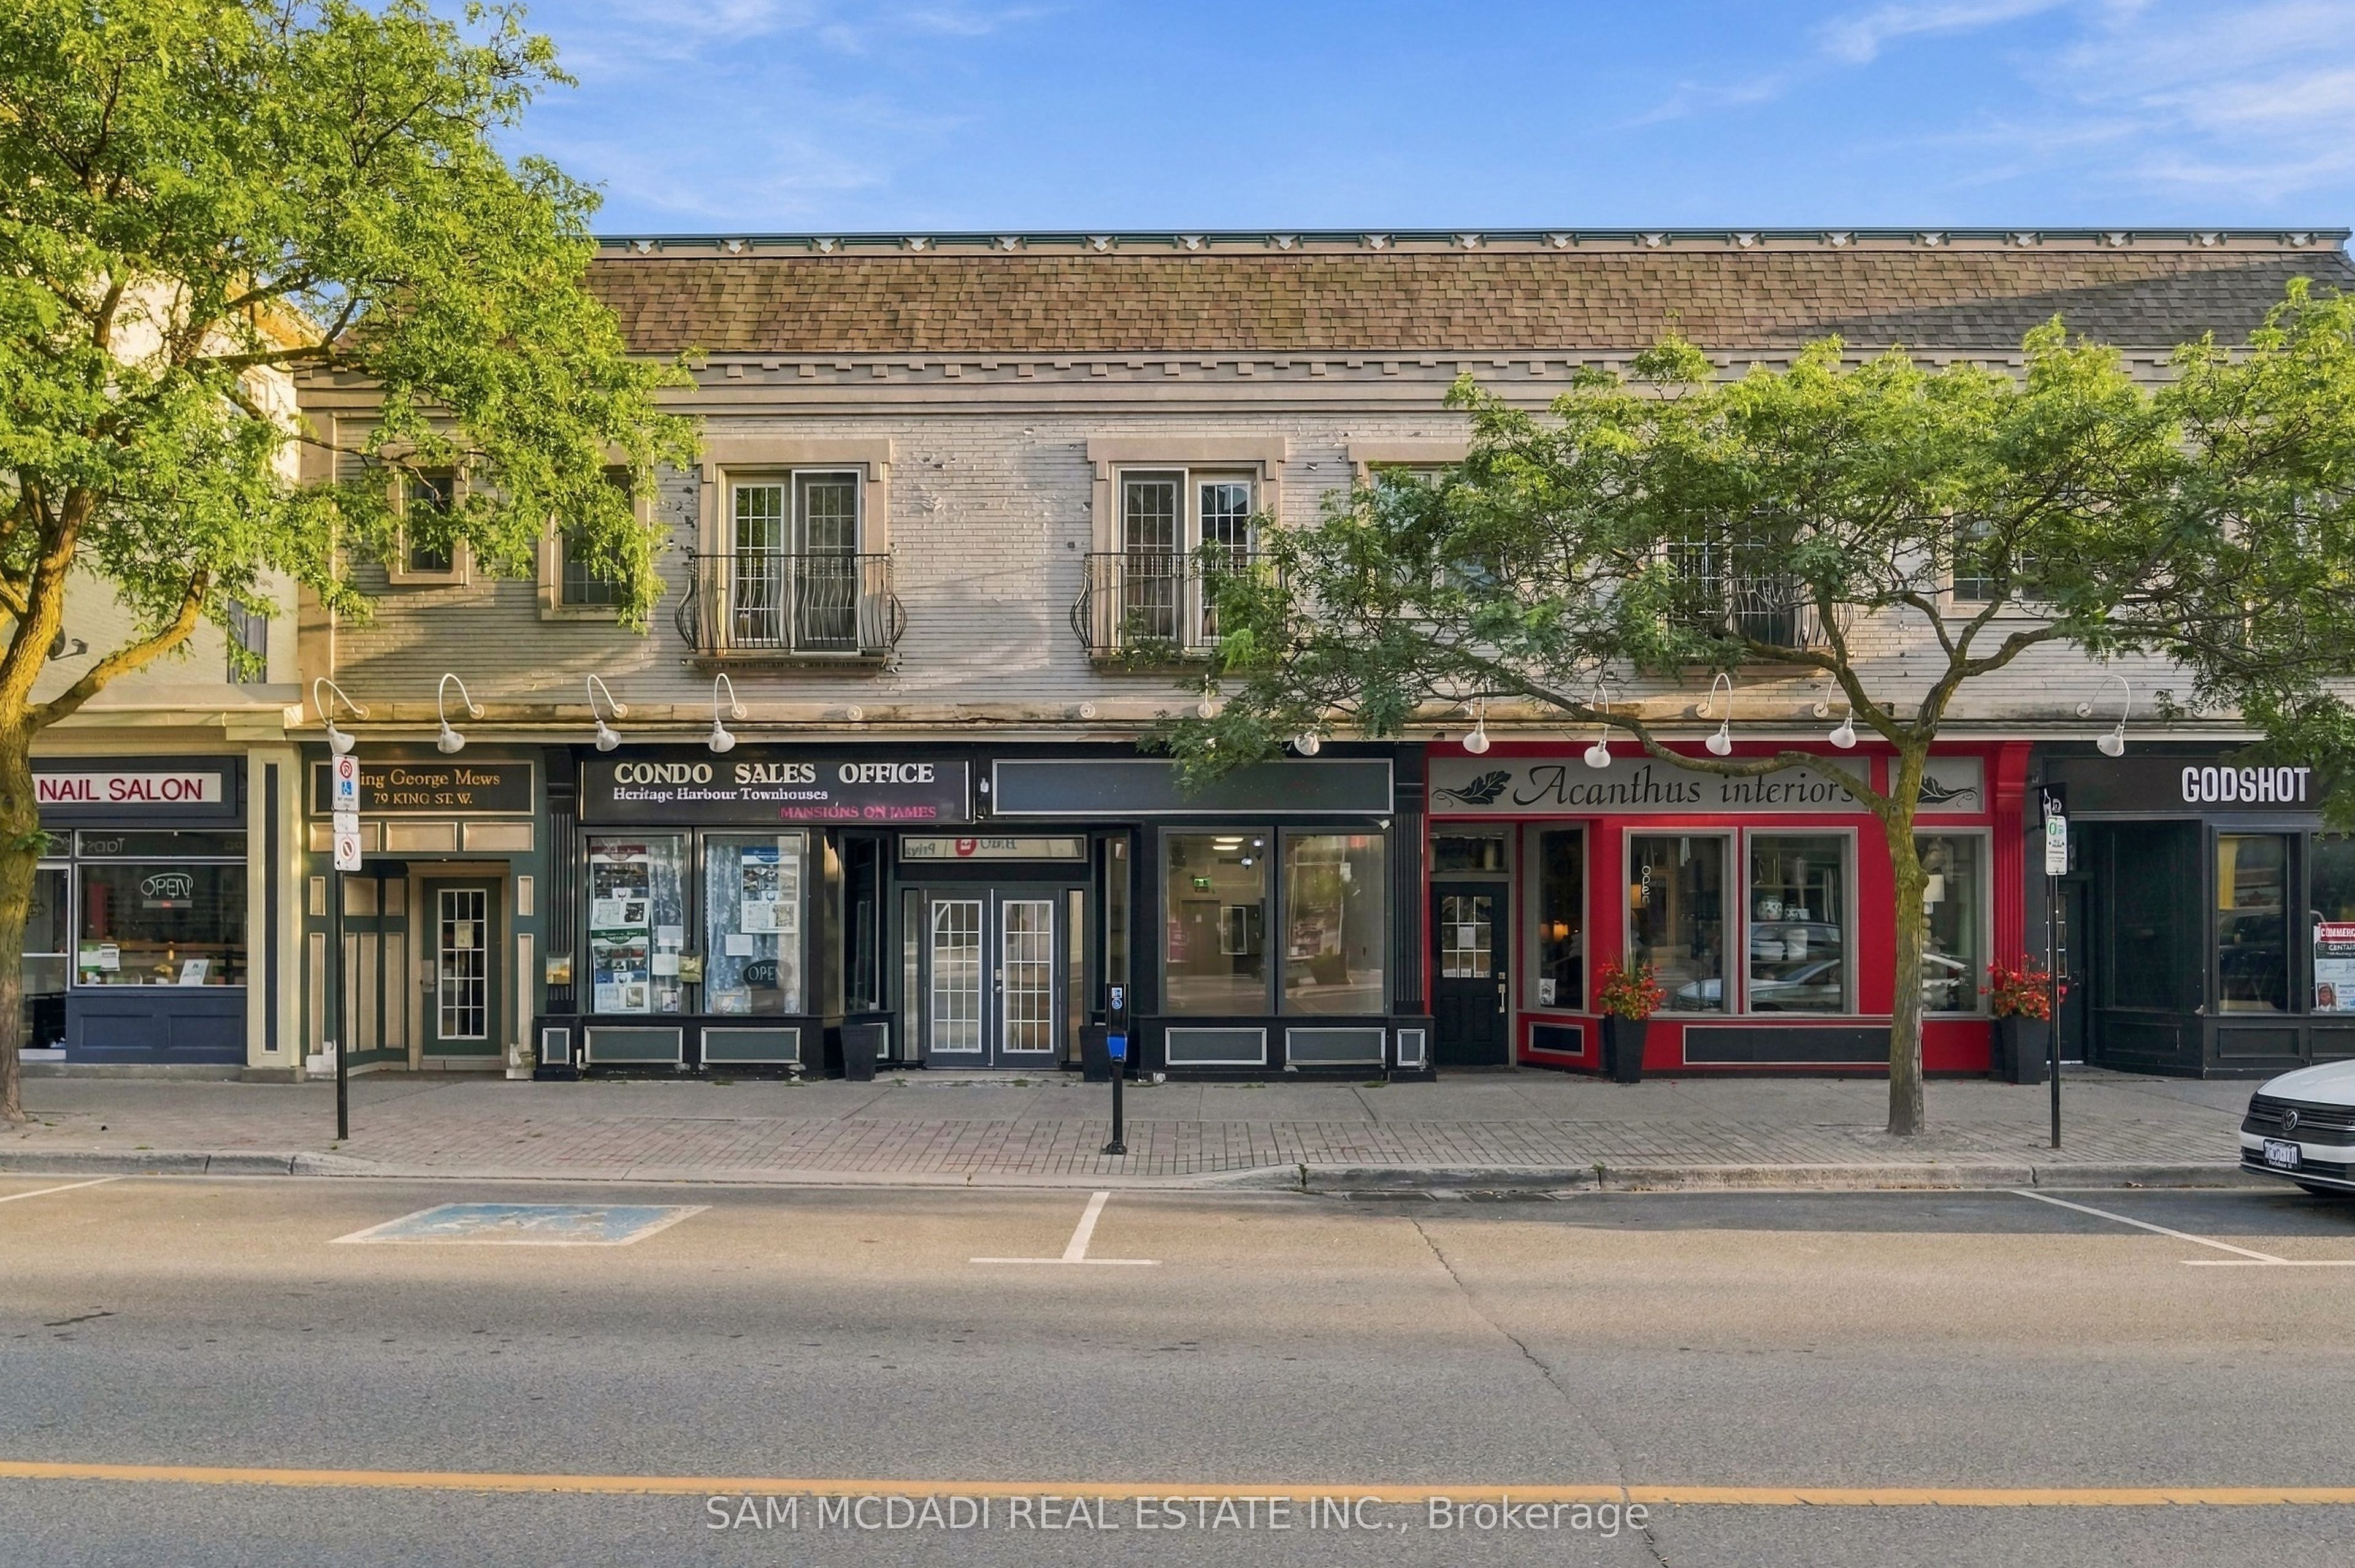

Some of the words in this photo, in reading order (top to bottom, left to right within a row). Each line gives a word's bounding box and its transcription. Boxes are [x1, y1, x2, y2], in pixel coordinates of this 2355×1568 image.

[359, 771, 385, 789] ing
[390, 768, 449, 789] George
[454, 768, 500, 786] Mews
[614, 763, 713, 784] CONDO
[735, 763, 816, 784] SALES
[838, 763, 935, 784] OFFICE
[39, 778, 101, 801] NAIL
[109, 778, 204, 801] SALON
[613, 787, 674, 803] Heritage
[676, 787, 737, 800] Harbour
[740, 787, 829, 800] Townhouses
[1513, 764, 1701, 806] Acanthus
[1720, 773, 1853, 803] interiors
[2181, 767, 2310, 803] GODSHOT
[374, 792, 388, 805] 79
[393, 793, 430, 805] KING
[435, 793, 454, 805] ST.
[457, 794, 473, 805] W.
[780, 806, 859, 819] MANSIONS
[864, 806, 886, 819] ON
[890, 806, 937, 819] JAMES
[140, 875, 191, 897] OPEN
